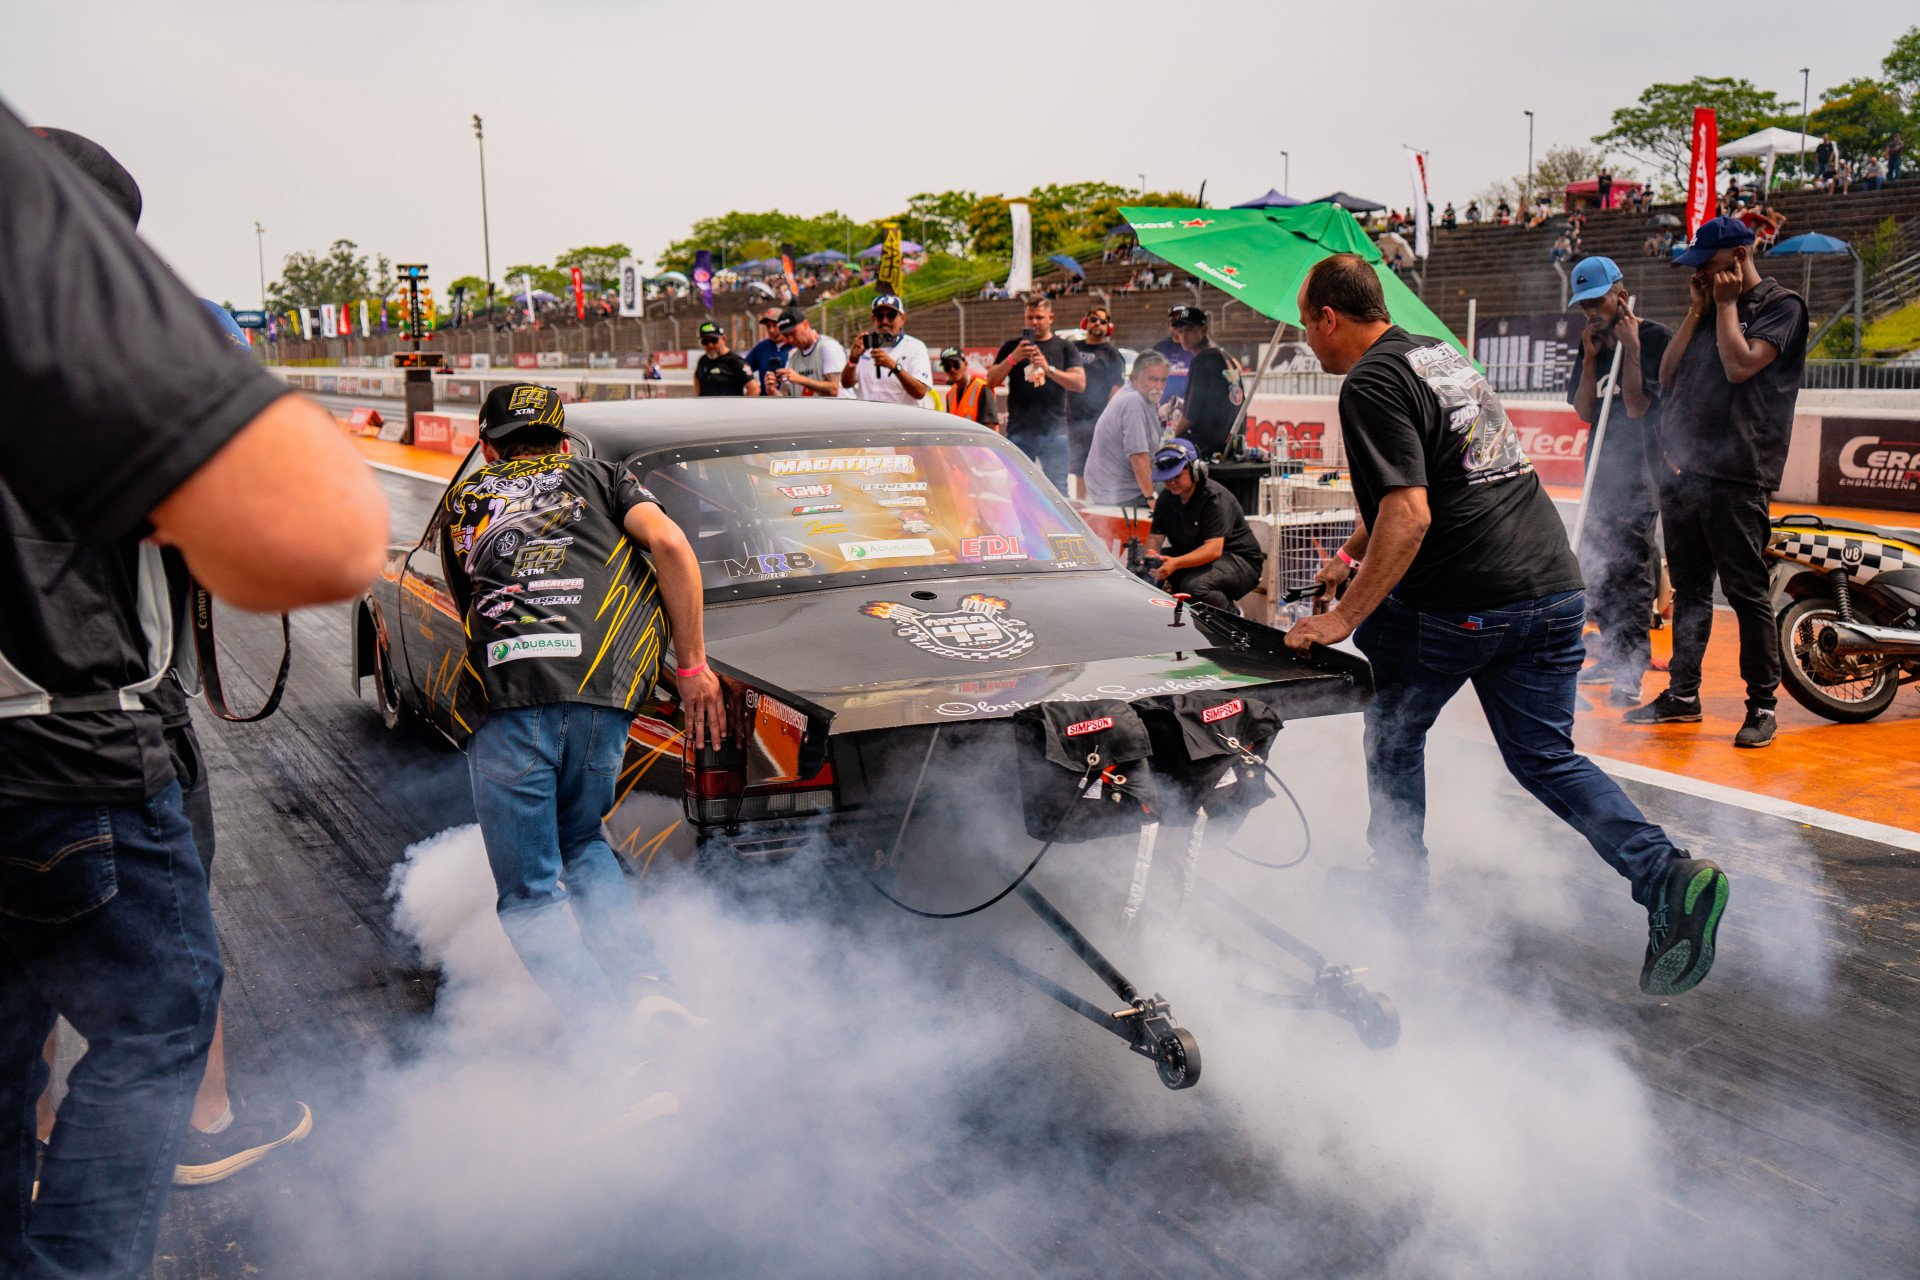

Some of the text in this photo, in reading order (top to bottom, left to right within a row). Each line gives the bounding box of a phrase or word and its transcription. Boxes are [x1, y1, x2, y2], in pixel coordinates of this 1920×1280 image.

[515, 408, 535, 416] XTM
[1514, 426, 1588, 456] Tech
[773, 456, 913, 475] MACATIVER
[1839, 477, 1917, 490] EMBREAGENS
[518, 568, 545, 578] XTM
[197, 589, 209, 630] Canon
[512, 639, 577, 651] ADUBASUL
[1205, 702, 1239, 721] SIMPSON
[1070, 718, 1110, 735] SIMPSON
